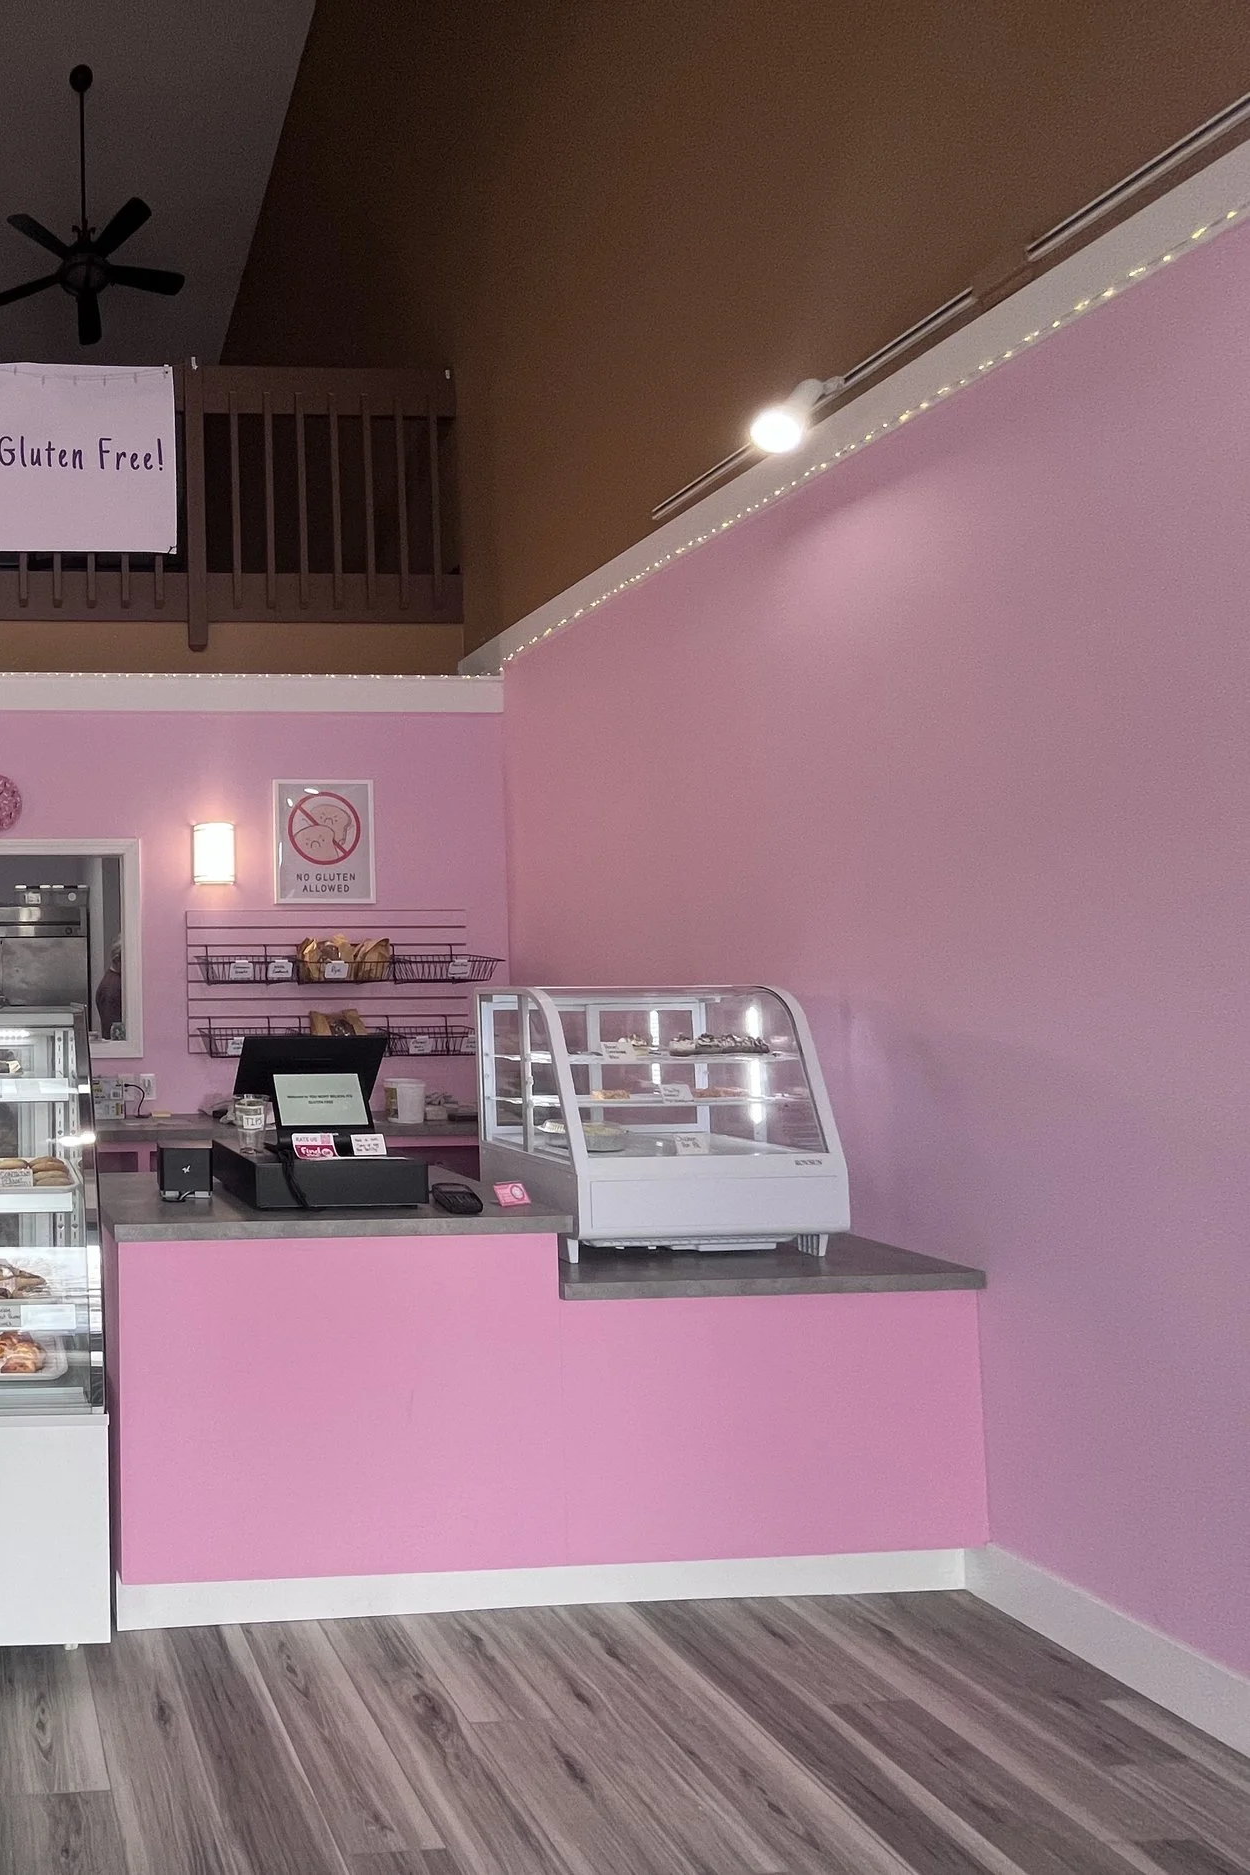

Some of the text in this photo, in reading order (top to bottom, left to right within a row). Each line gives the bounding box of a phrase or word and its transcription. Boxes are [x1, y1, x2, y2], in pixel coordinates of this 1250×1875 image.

[98, 437, 164, 471] Free!
[296, 872, 356, 882] NO GLUTEN
[302, 884, 350, 893] ALLOWED
[245, 1117, 263, 1126] TIPS
